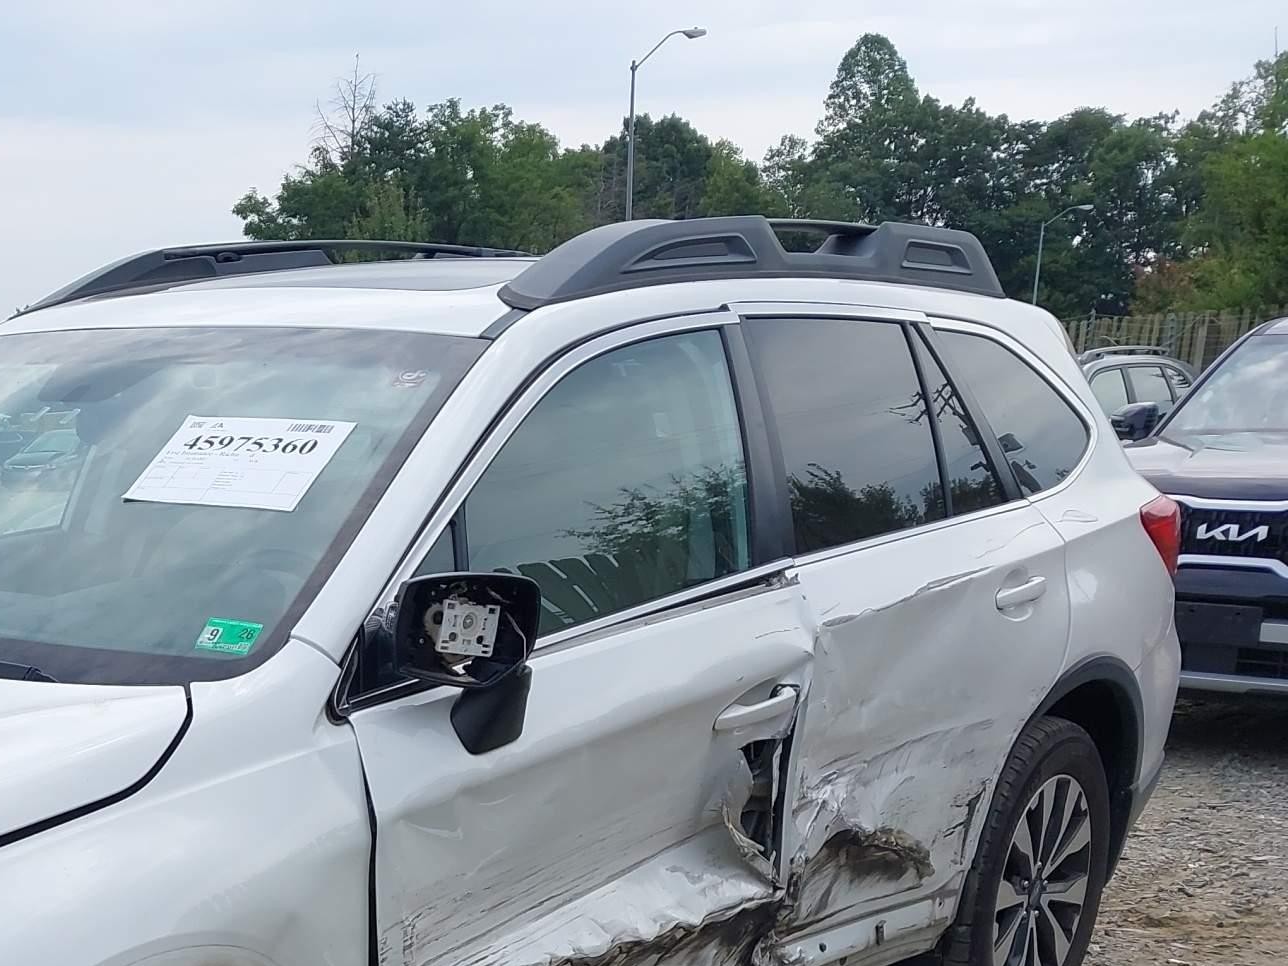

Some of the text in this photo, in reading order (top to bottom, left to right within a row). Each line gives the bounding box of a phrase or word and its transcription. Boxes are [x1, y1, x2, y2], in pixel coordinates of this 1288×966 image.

[183, 434, 319, 455] 45975360
[1196, 522, 1270, 543] KIA
[208, 628, 220, 642] 9
